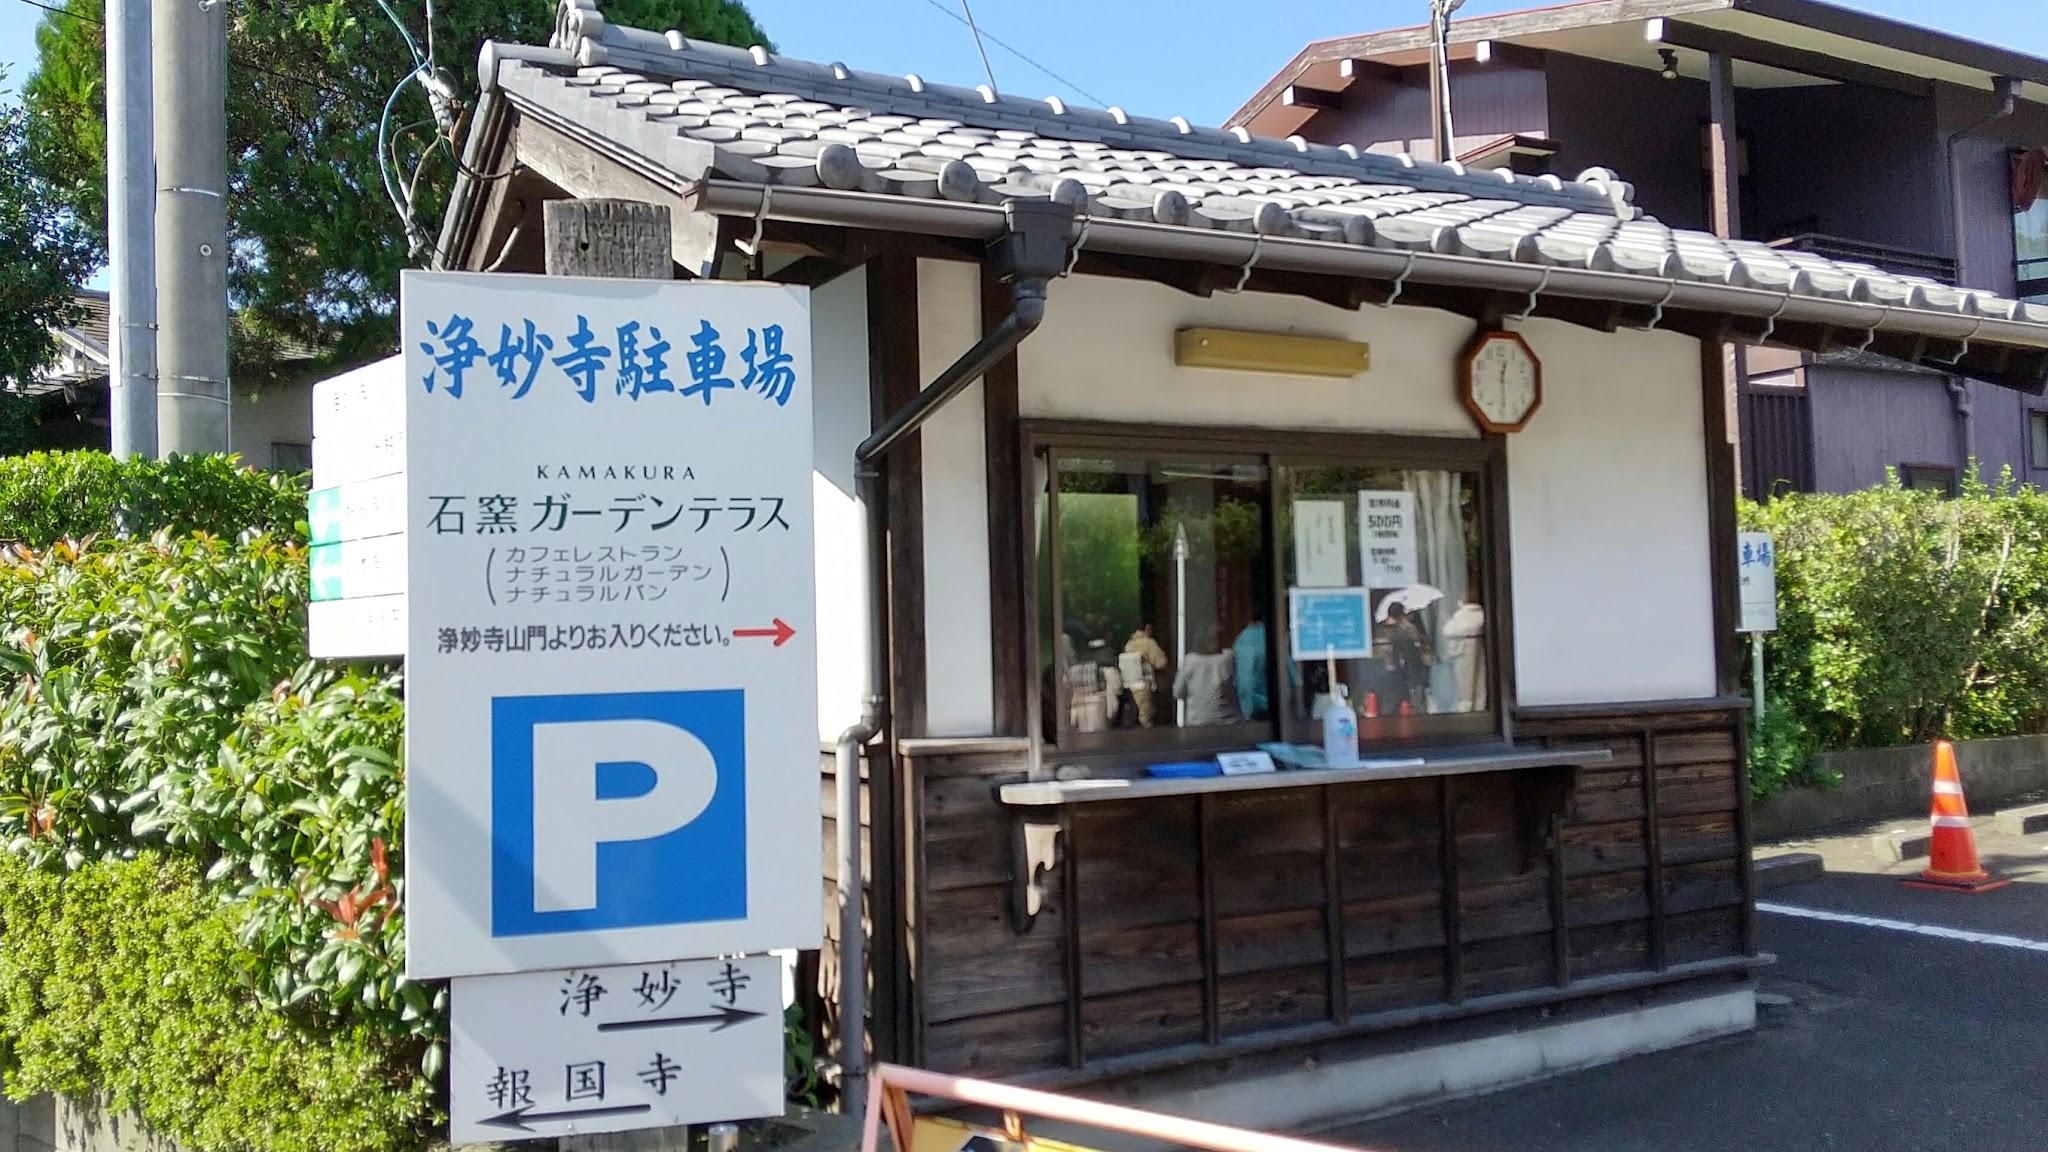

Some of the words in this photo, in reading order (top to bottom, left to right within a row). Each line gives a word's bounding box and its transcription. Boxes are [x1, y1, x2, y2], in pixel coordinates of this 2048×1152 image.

[419, 313, 796, 406] 浄妙寺駐車場
[537, 465, 696, 481] KAMAKURA
[506, 546, 683, 563] カフェレストラン
[506, 565, 713, 582] ナチュラルガーデン
[506, 585, 668, 603] ナチュラルパン
[438, 623, 731, 654] 浄妙寺山門よりお入りください。
[533, 719, 718, 913] P
[559, 962, 752, 1018] 浄妙寺
[485, 1053, 682, 1109] 報国寺
